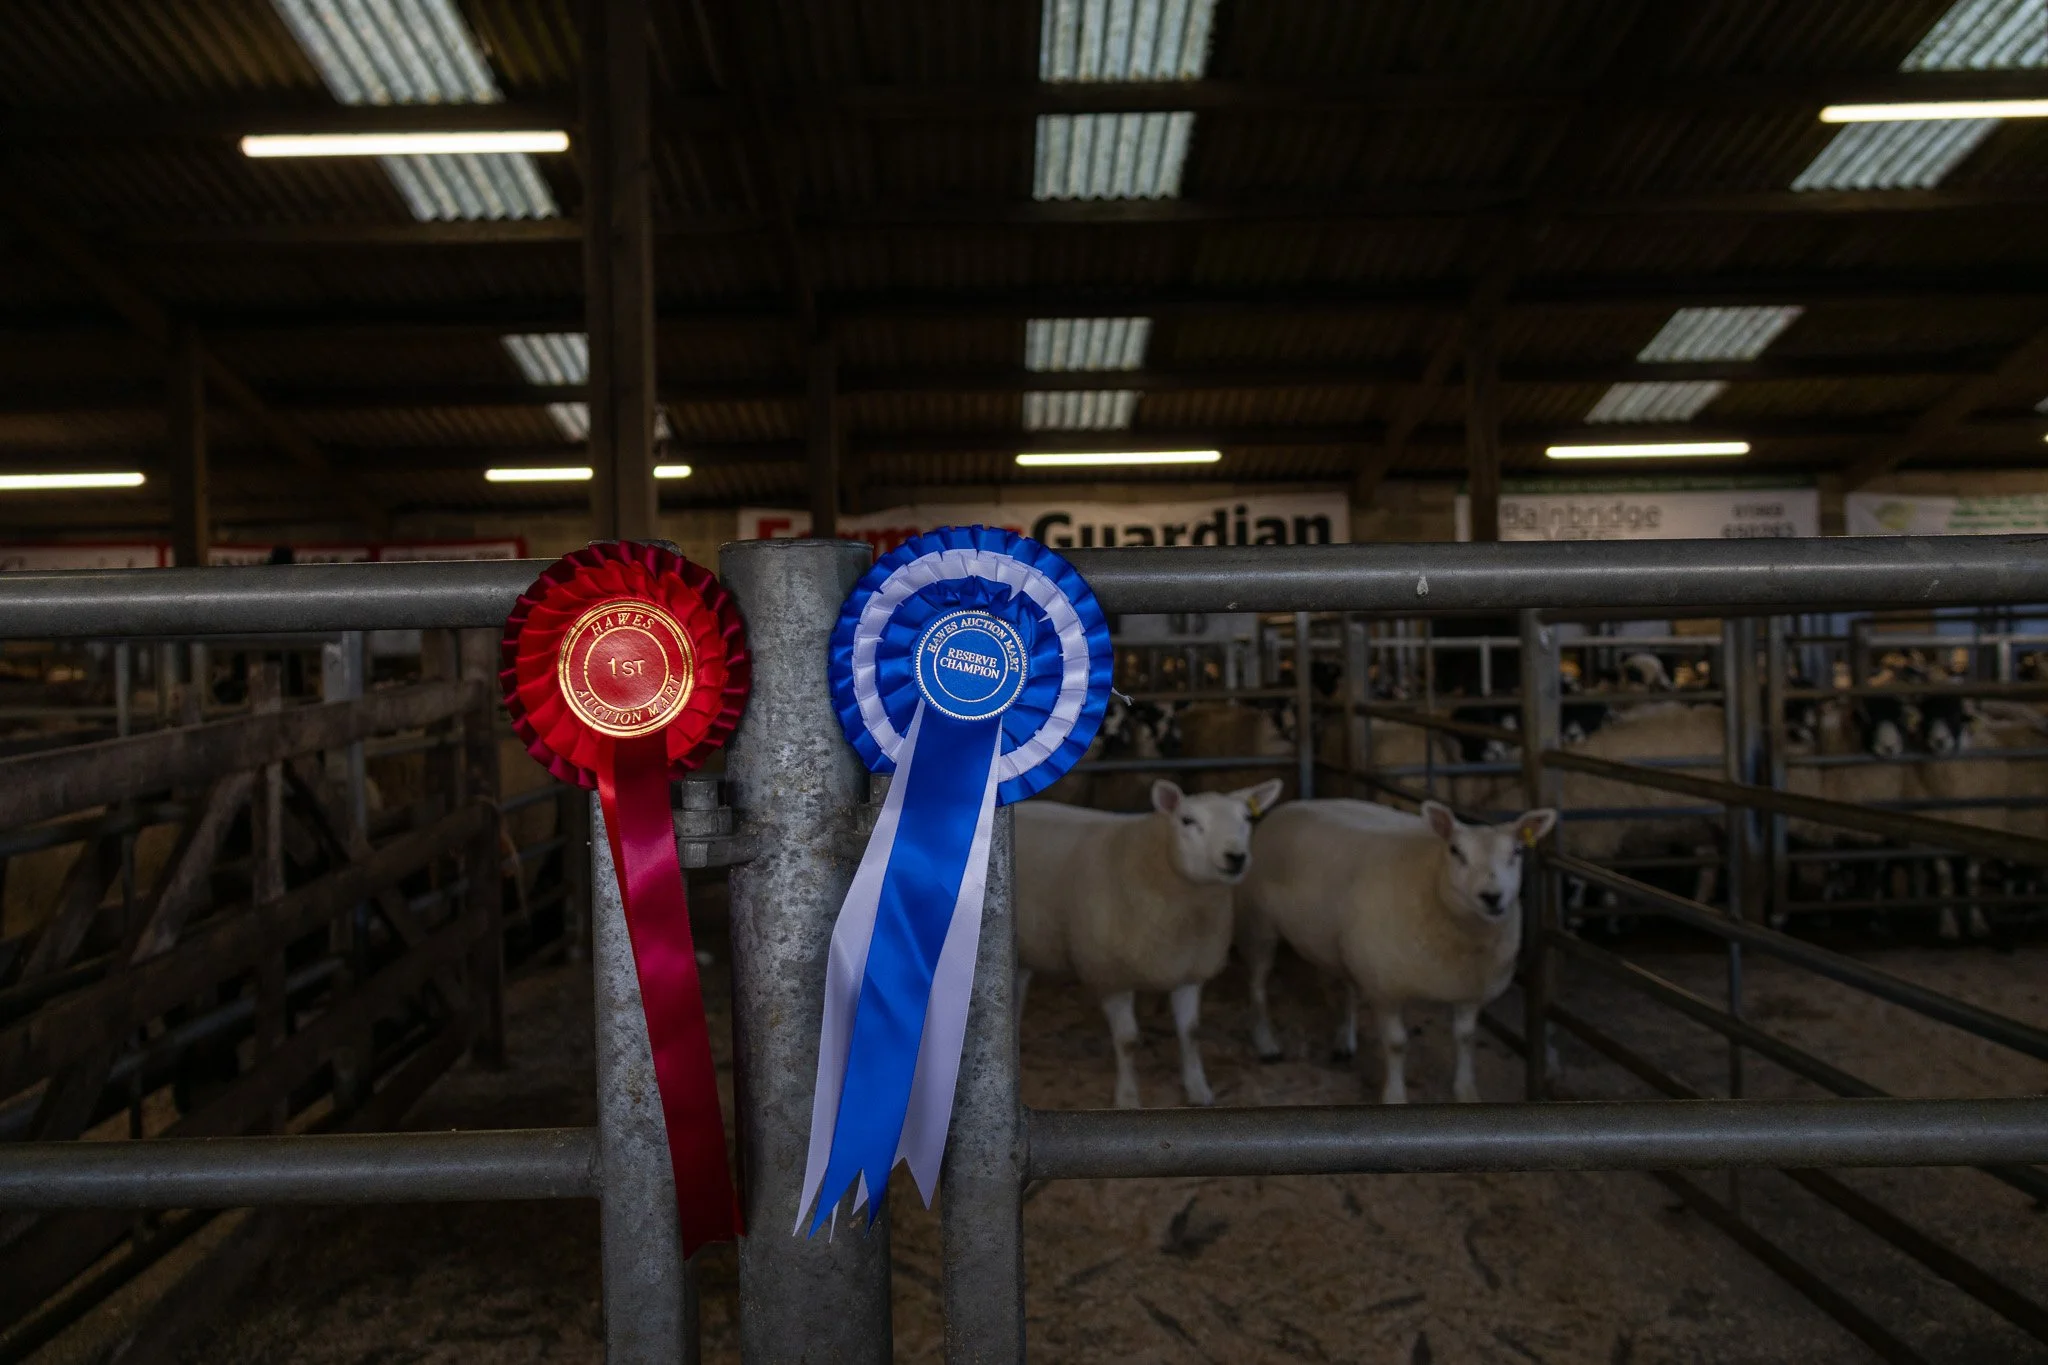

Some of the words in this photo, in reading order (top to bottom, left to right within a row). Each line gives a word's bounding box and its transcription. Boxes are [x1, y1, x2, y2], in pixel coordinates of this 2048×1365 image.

[1032, 505, 1331, 546] Guardian
[591, 612, 655, 636] HAWES
[927, 621, 958, 653] HAWES
[961, 617, 1007, 639] AUCTION
[1004, 638, 1020, 673] MART
[608, 657, 645, 676] 1ST
[939, 656, 1000, 680] CHAMPION
[947, 647, 997, 668] RESERVE
[576, 689, 642, 724] AUCTION
[647, 674, 680, 718] MART
